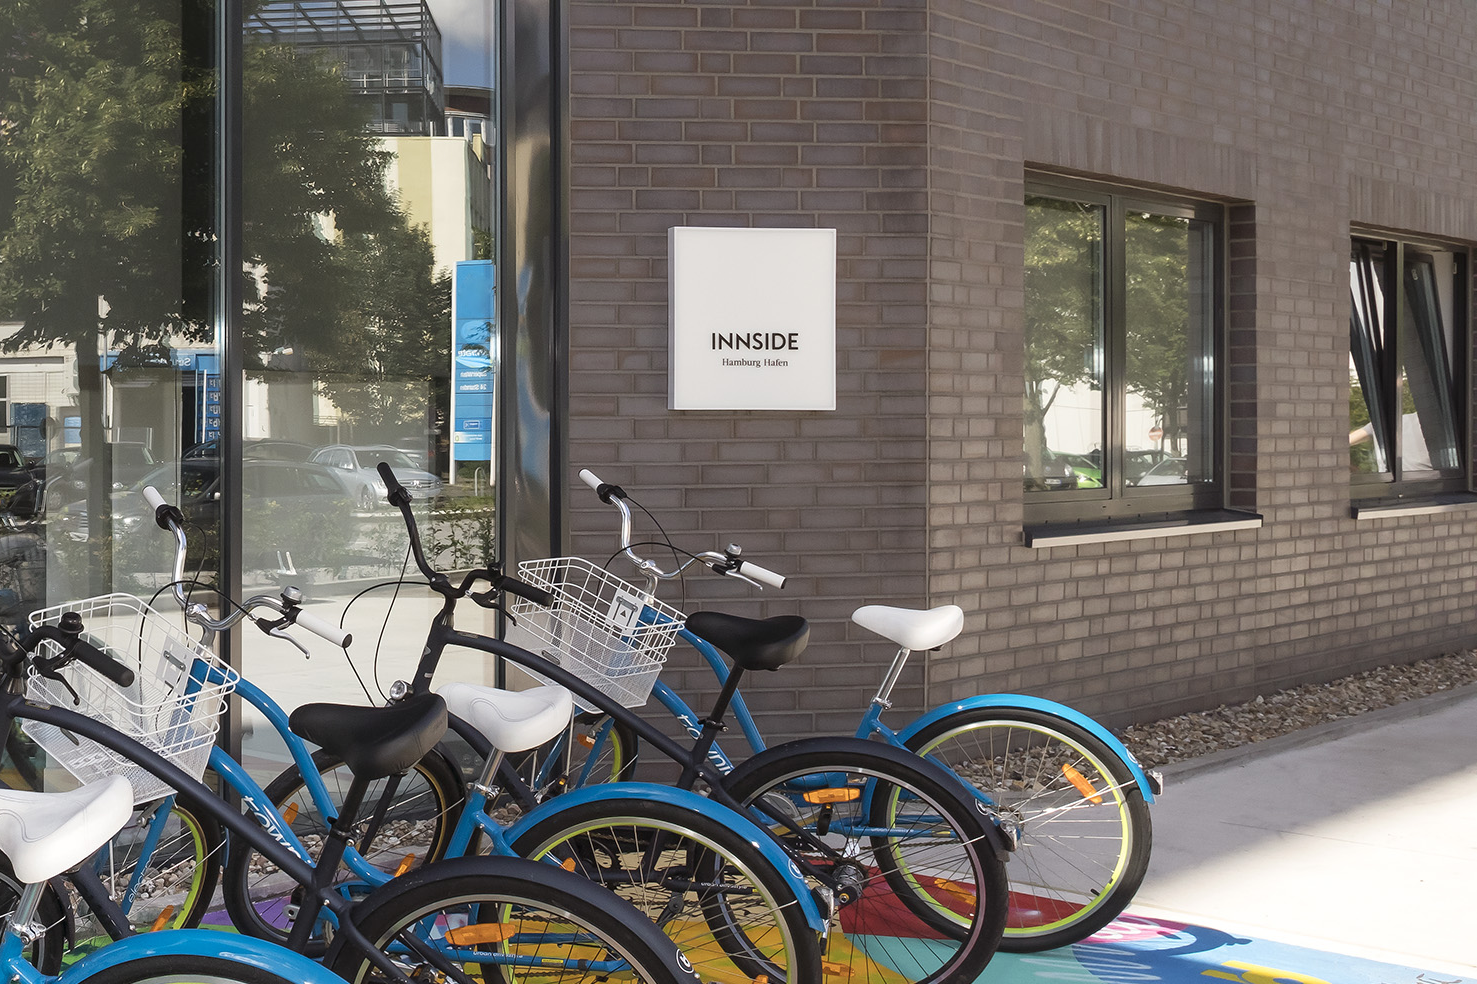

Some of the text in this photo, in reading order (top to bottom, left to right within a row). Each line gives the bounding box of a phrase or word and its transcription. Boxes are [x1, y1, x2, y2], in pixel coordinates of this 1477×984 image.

[712, 333, 798, 350] INNSIDE
[722, 358, 788, 368] Hamburg Hafen
